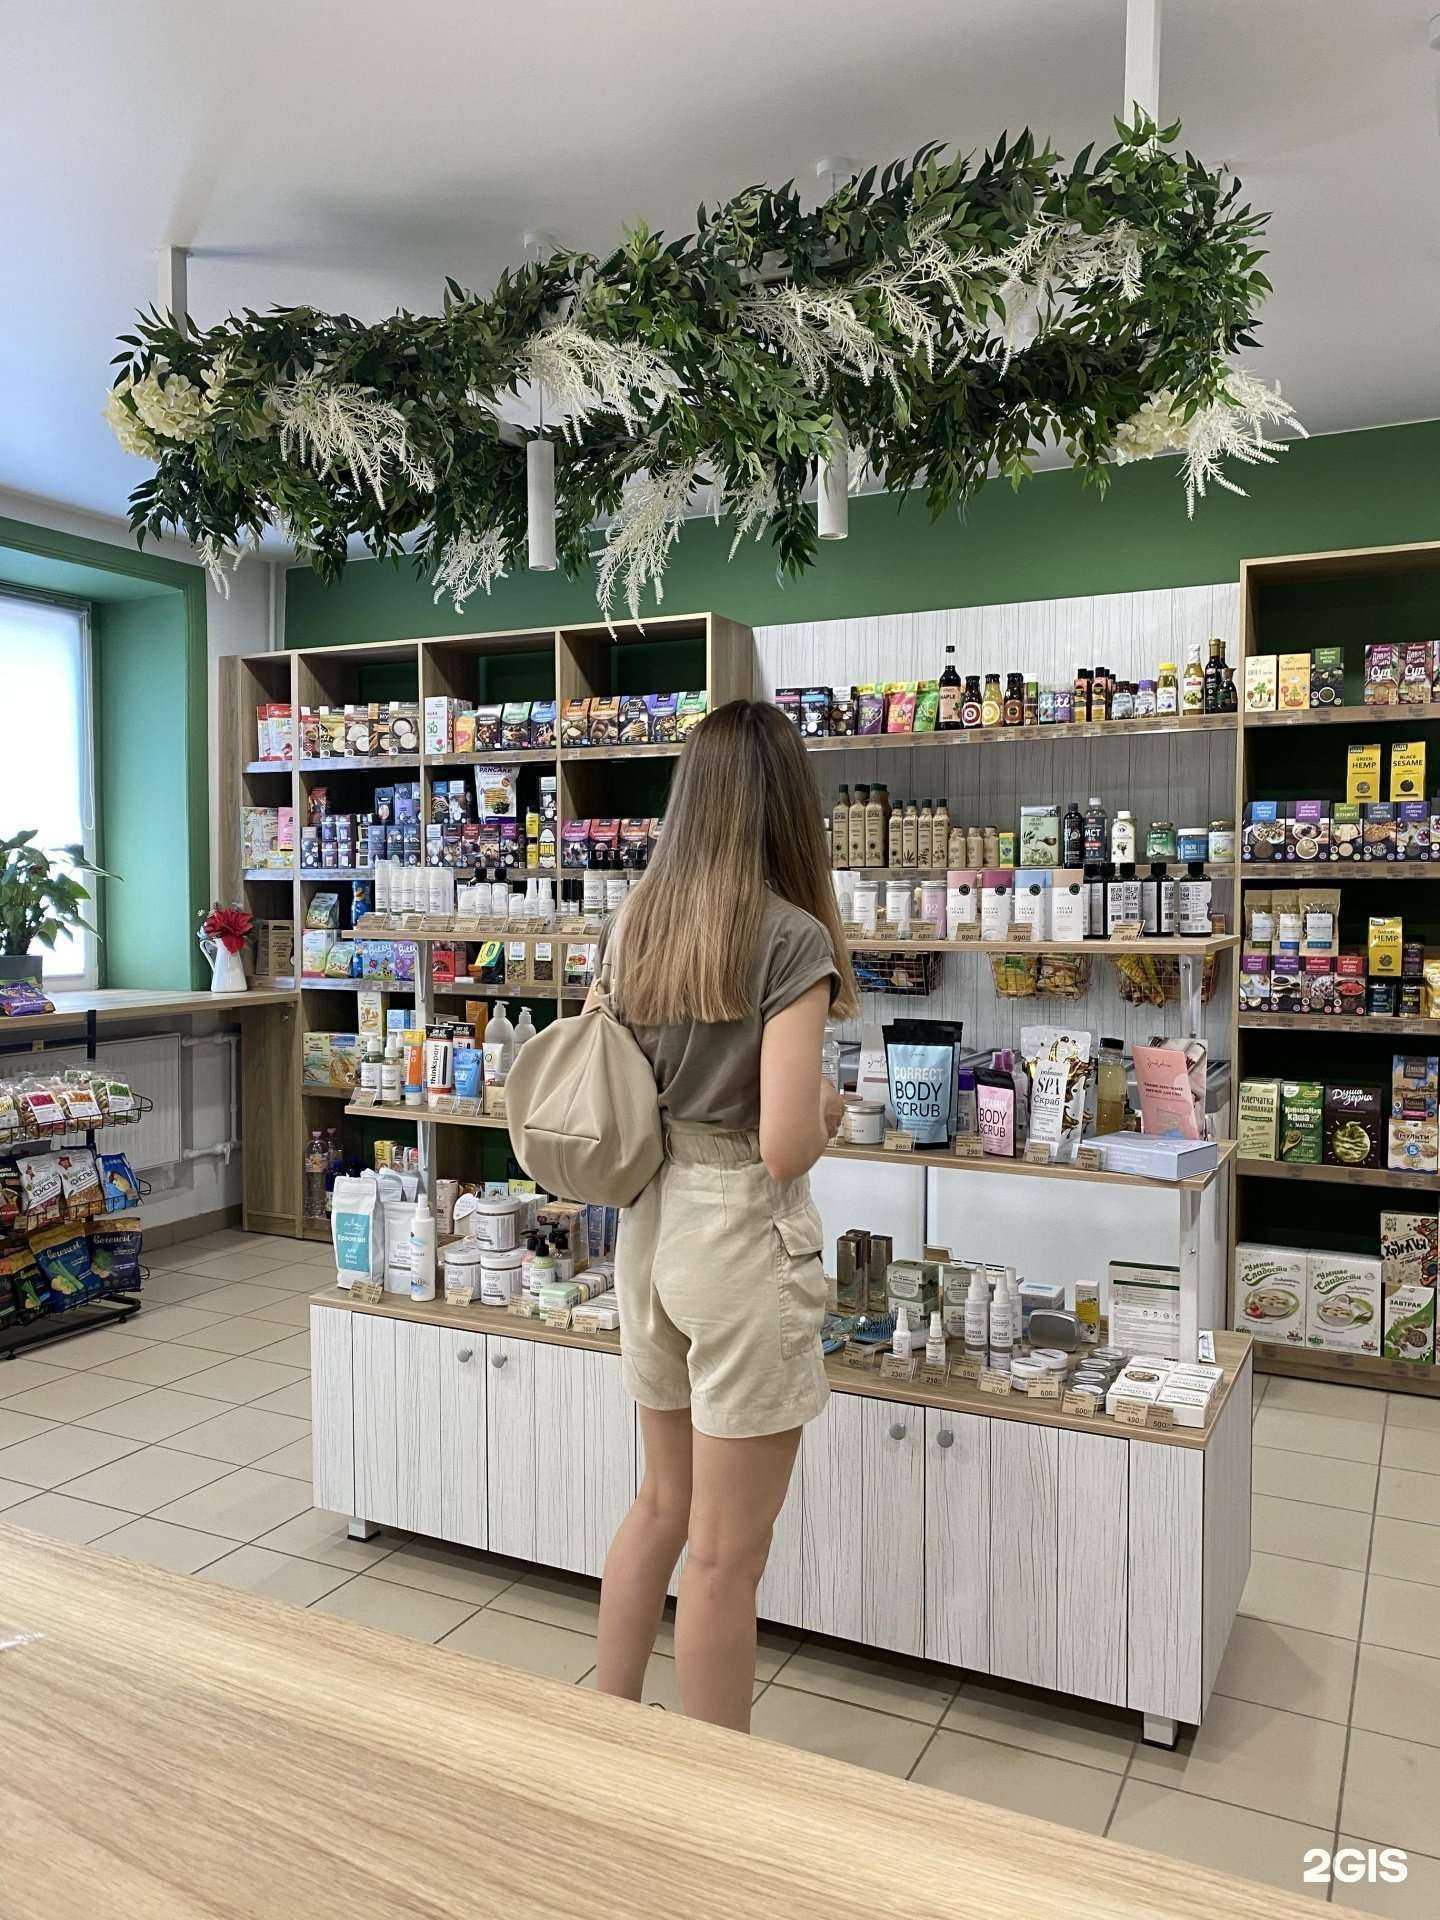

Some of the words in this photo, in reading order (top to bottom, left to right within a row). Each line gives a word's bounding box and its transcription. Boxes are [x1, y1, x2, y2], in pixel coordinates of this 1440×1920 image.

[479, 766, 513, 774] PANCAKE
[1352, 761, 1377, 769] HEMP
[1392, 759, 1423, 768] SESAME
[1084, 829, 1101, 837] MCT
[1374, 934, 1399, 942] HEMP
[430, 1045, 439, 1085] thinksport
[894, 1066, 944, 1081] CORRECT
[895, 1080, 943, 1102] BODY
[1037, 1076, 1060, 1096] SPA
[1033, 1094, 1060, 1106] Скраб
[1344, 1090, 1374, 1107] зерна
[896, 1101, 940, 1118] SCRUB
[979, 1108, 1008, 1126] BODY
[979, 1123, 1006, 1138] SCRUB
[1242, 1266, 1288, 1282] Сладости
[1314, 1274, 1361, 1290] Сладости
[1390, 1300, 1422, 1308] ЗАВТРАК
[1152, 1420, 1167, 1429] 500
